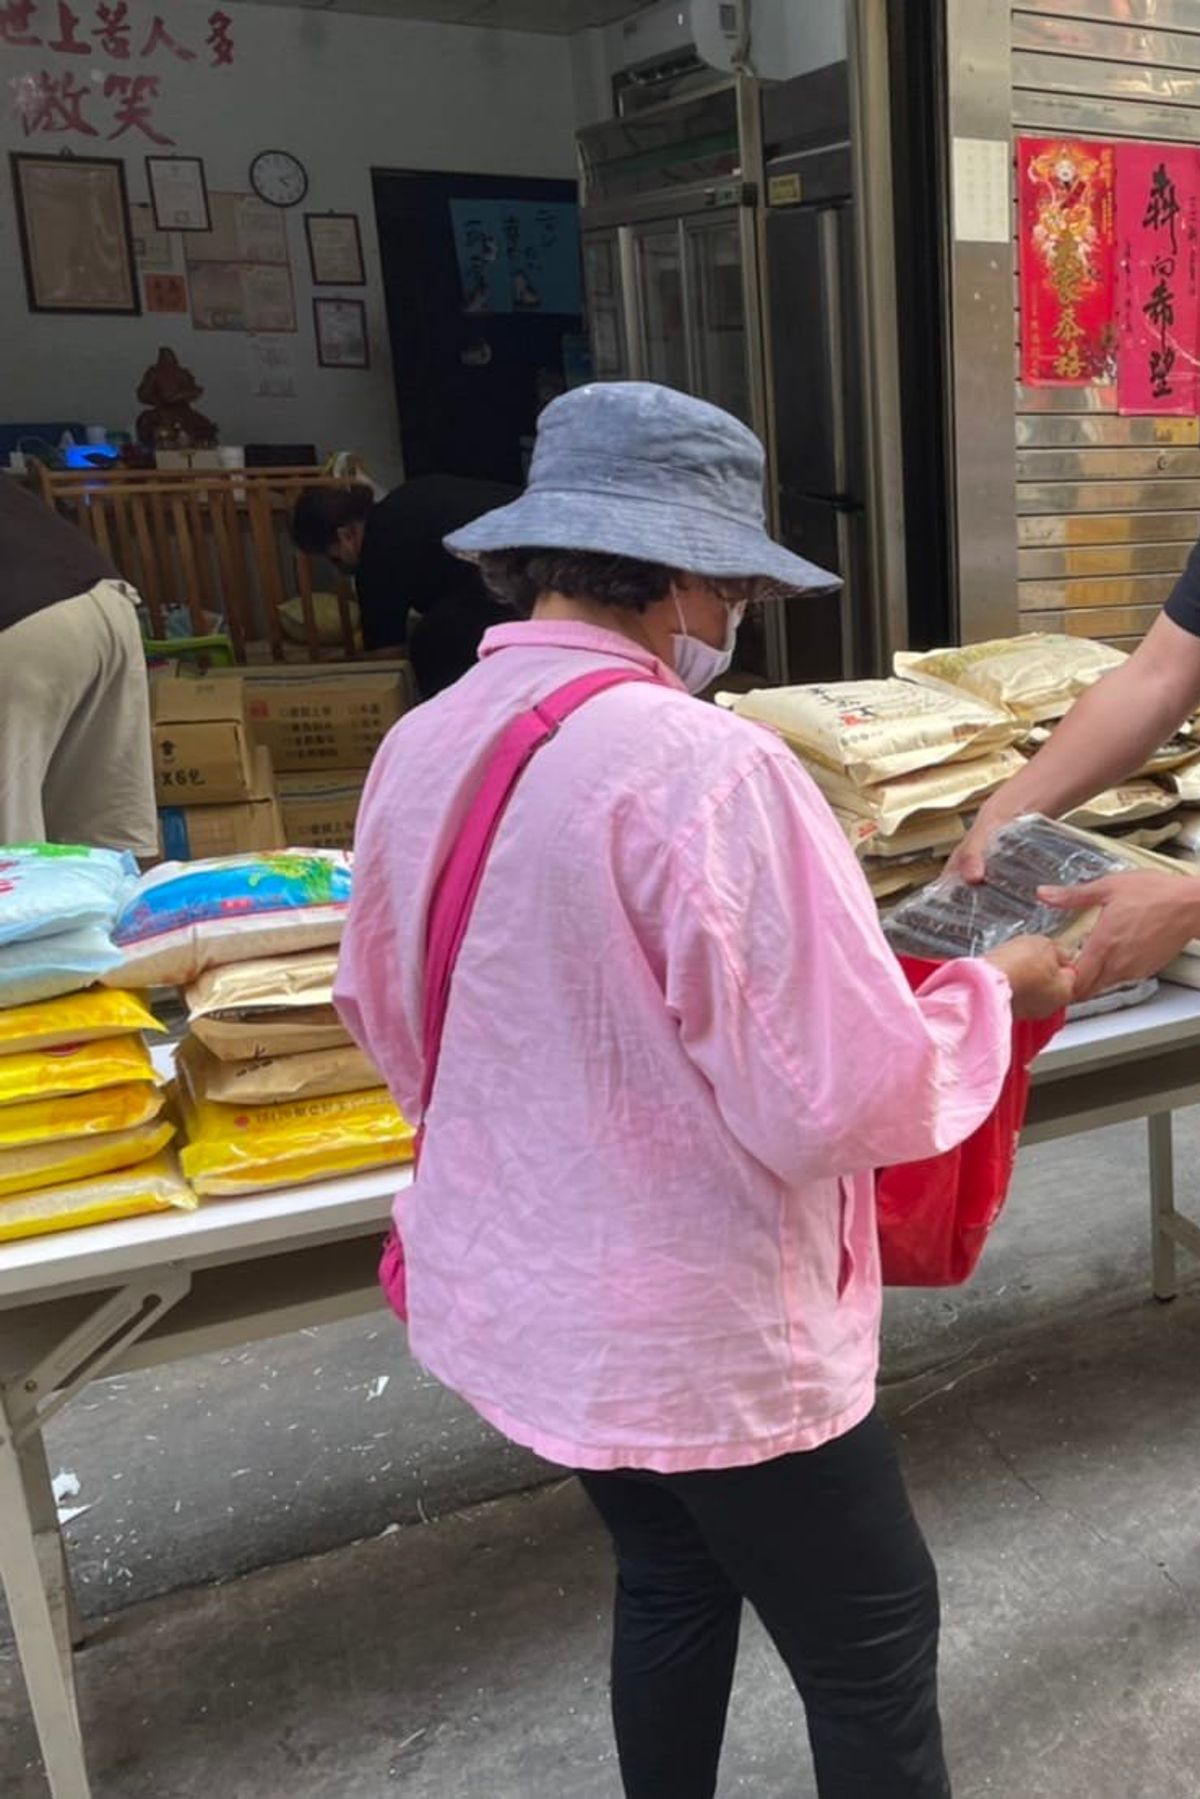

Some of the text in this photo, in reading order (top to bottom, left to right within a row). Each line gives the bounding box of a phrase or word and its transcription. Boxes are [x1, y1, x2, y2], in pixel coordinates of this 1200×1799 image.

[0, 0, 235, 67] 世上苦人多
